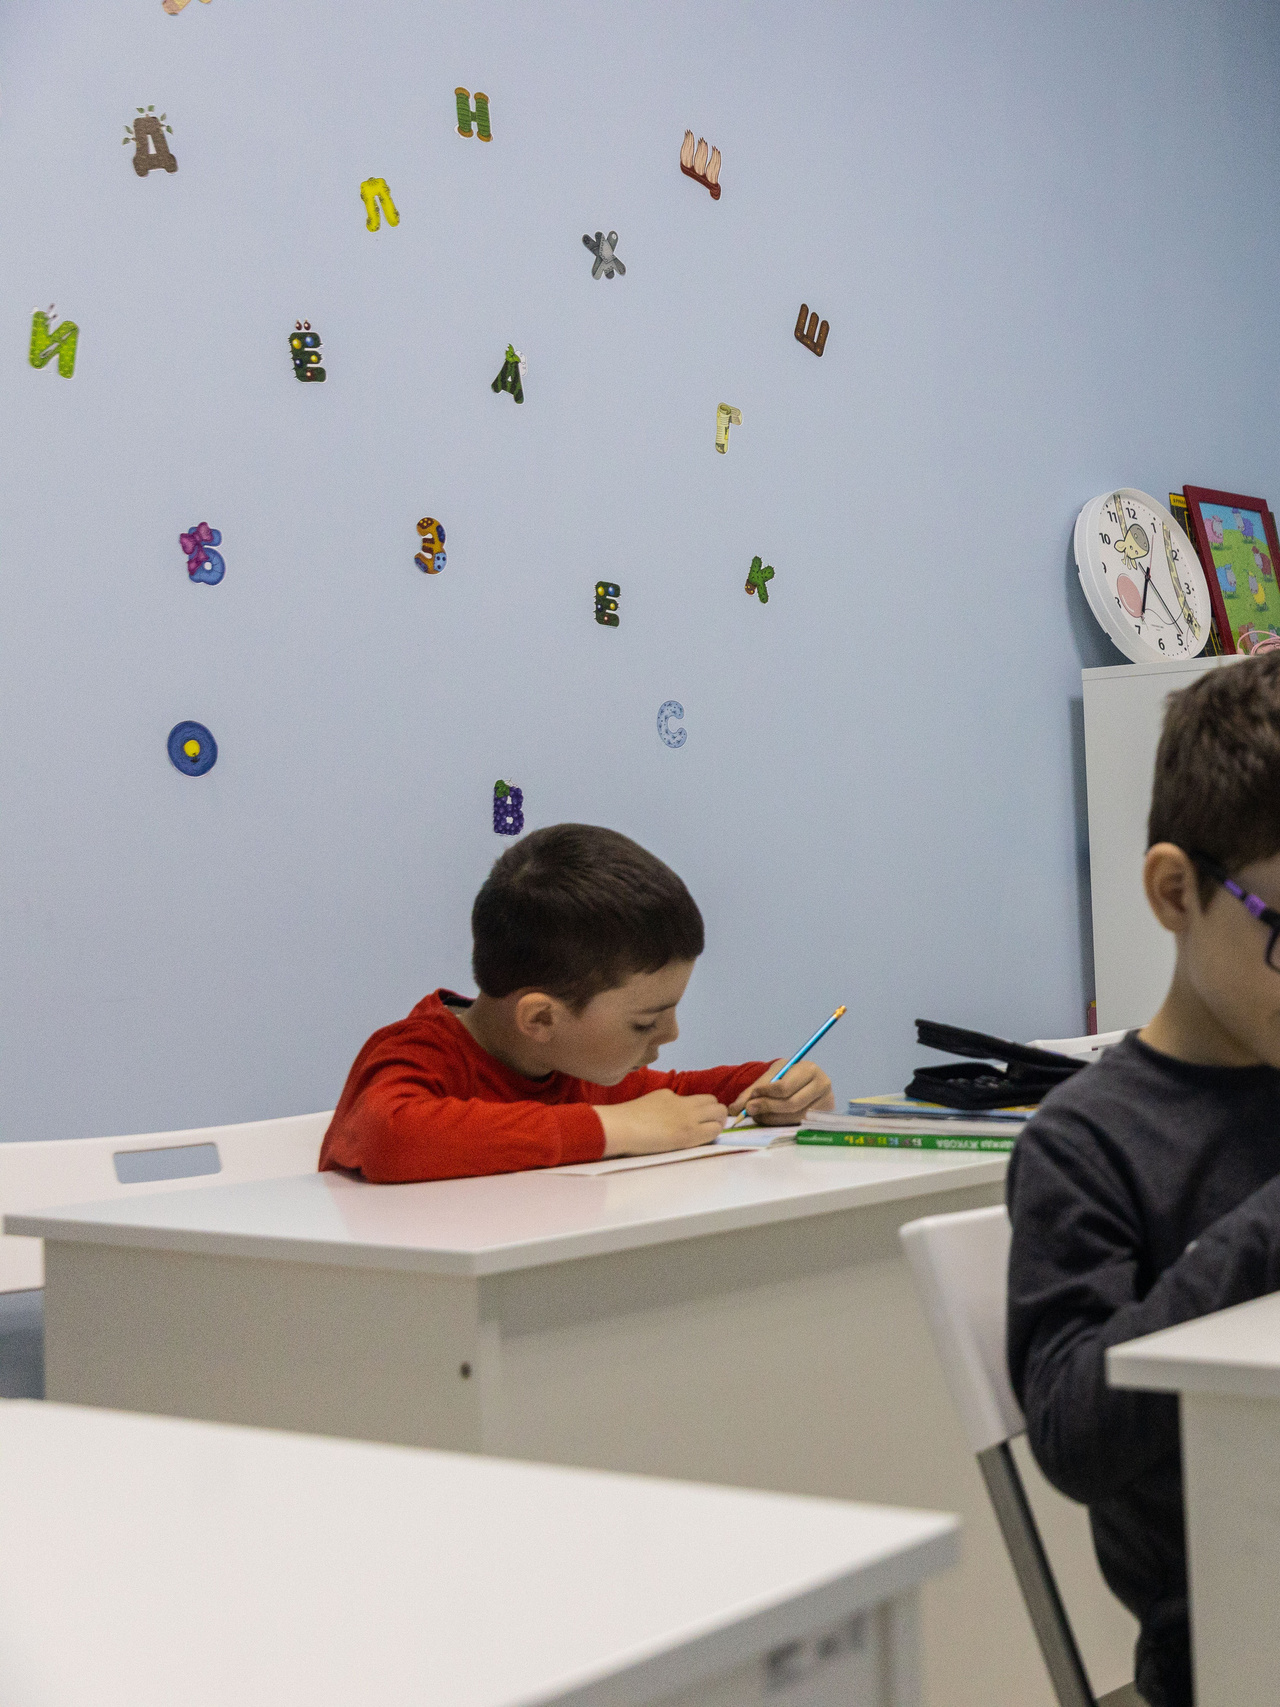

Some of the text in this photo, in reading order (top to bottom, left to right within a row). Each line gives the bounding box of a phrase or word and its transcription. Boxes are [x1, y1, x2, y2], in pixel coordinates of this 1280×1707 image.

[455, 87, 493, 142] Н
[130, 108, 179, 177] Д
[582, 230, 626, 280] Ж
[287, 319, 327, 383] Ё
[794, 303, 829, 357] Ш
[491, 343, 524, 404] А
[715, 402, 742, 454] Г
[1107, 511, 1118, 523] 11
[1126, 507, 1137, 520] 12
[1151, 522, 1157, 534] 1
[180, 522, 226, 586] Б
[413, 516, 447, 576] З
[1099, 532, 1111, 545] 10
[744, 555, 776, 604] К
[1184, 582, 1191, 595] 3
[594, 581, 622, 628] Е
[1135, 624, 1141, 635] 7
[1158, 638, 1165, 651] 6
[1177, 634, 1184, 646] 5
[166, 719, 219, 778] О
[656, 700, 688, 749] С
[493, 779, 524, 836] В
